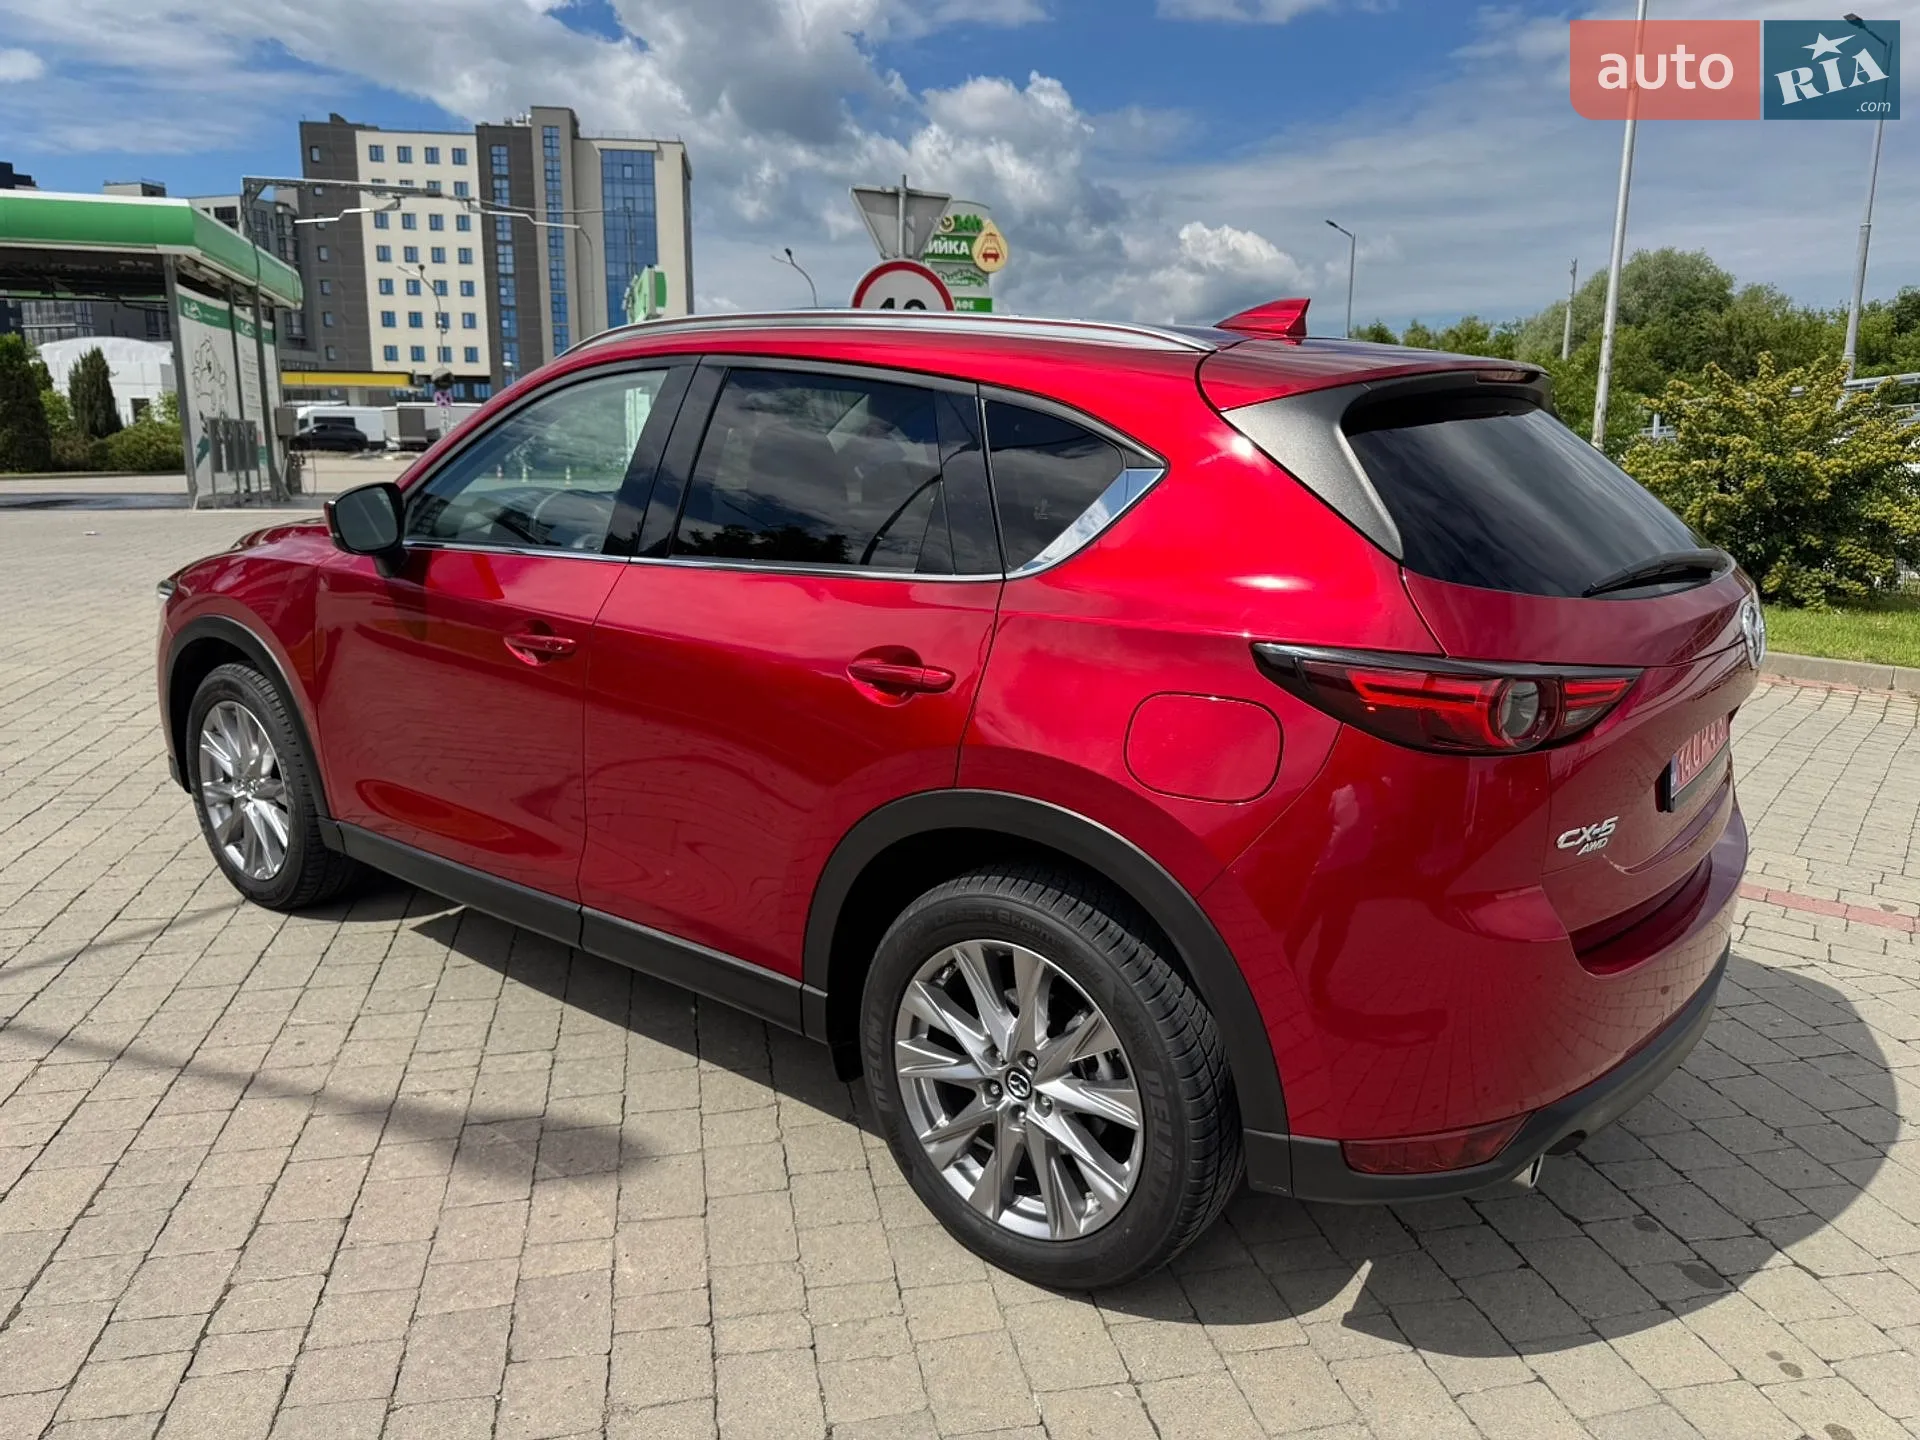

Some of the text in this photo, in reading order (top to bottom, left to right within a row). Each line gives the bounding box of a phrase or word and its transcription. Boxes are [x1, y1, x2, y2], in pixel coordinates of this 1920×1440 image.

[926, 236, 970, 255] ИЙКА
[955, 300, 975, 310] АФЕ
[1556, 815, 1619, 849] CX-5
[1576, 836, 1608, 856] AWD
